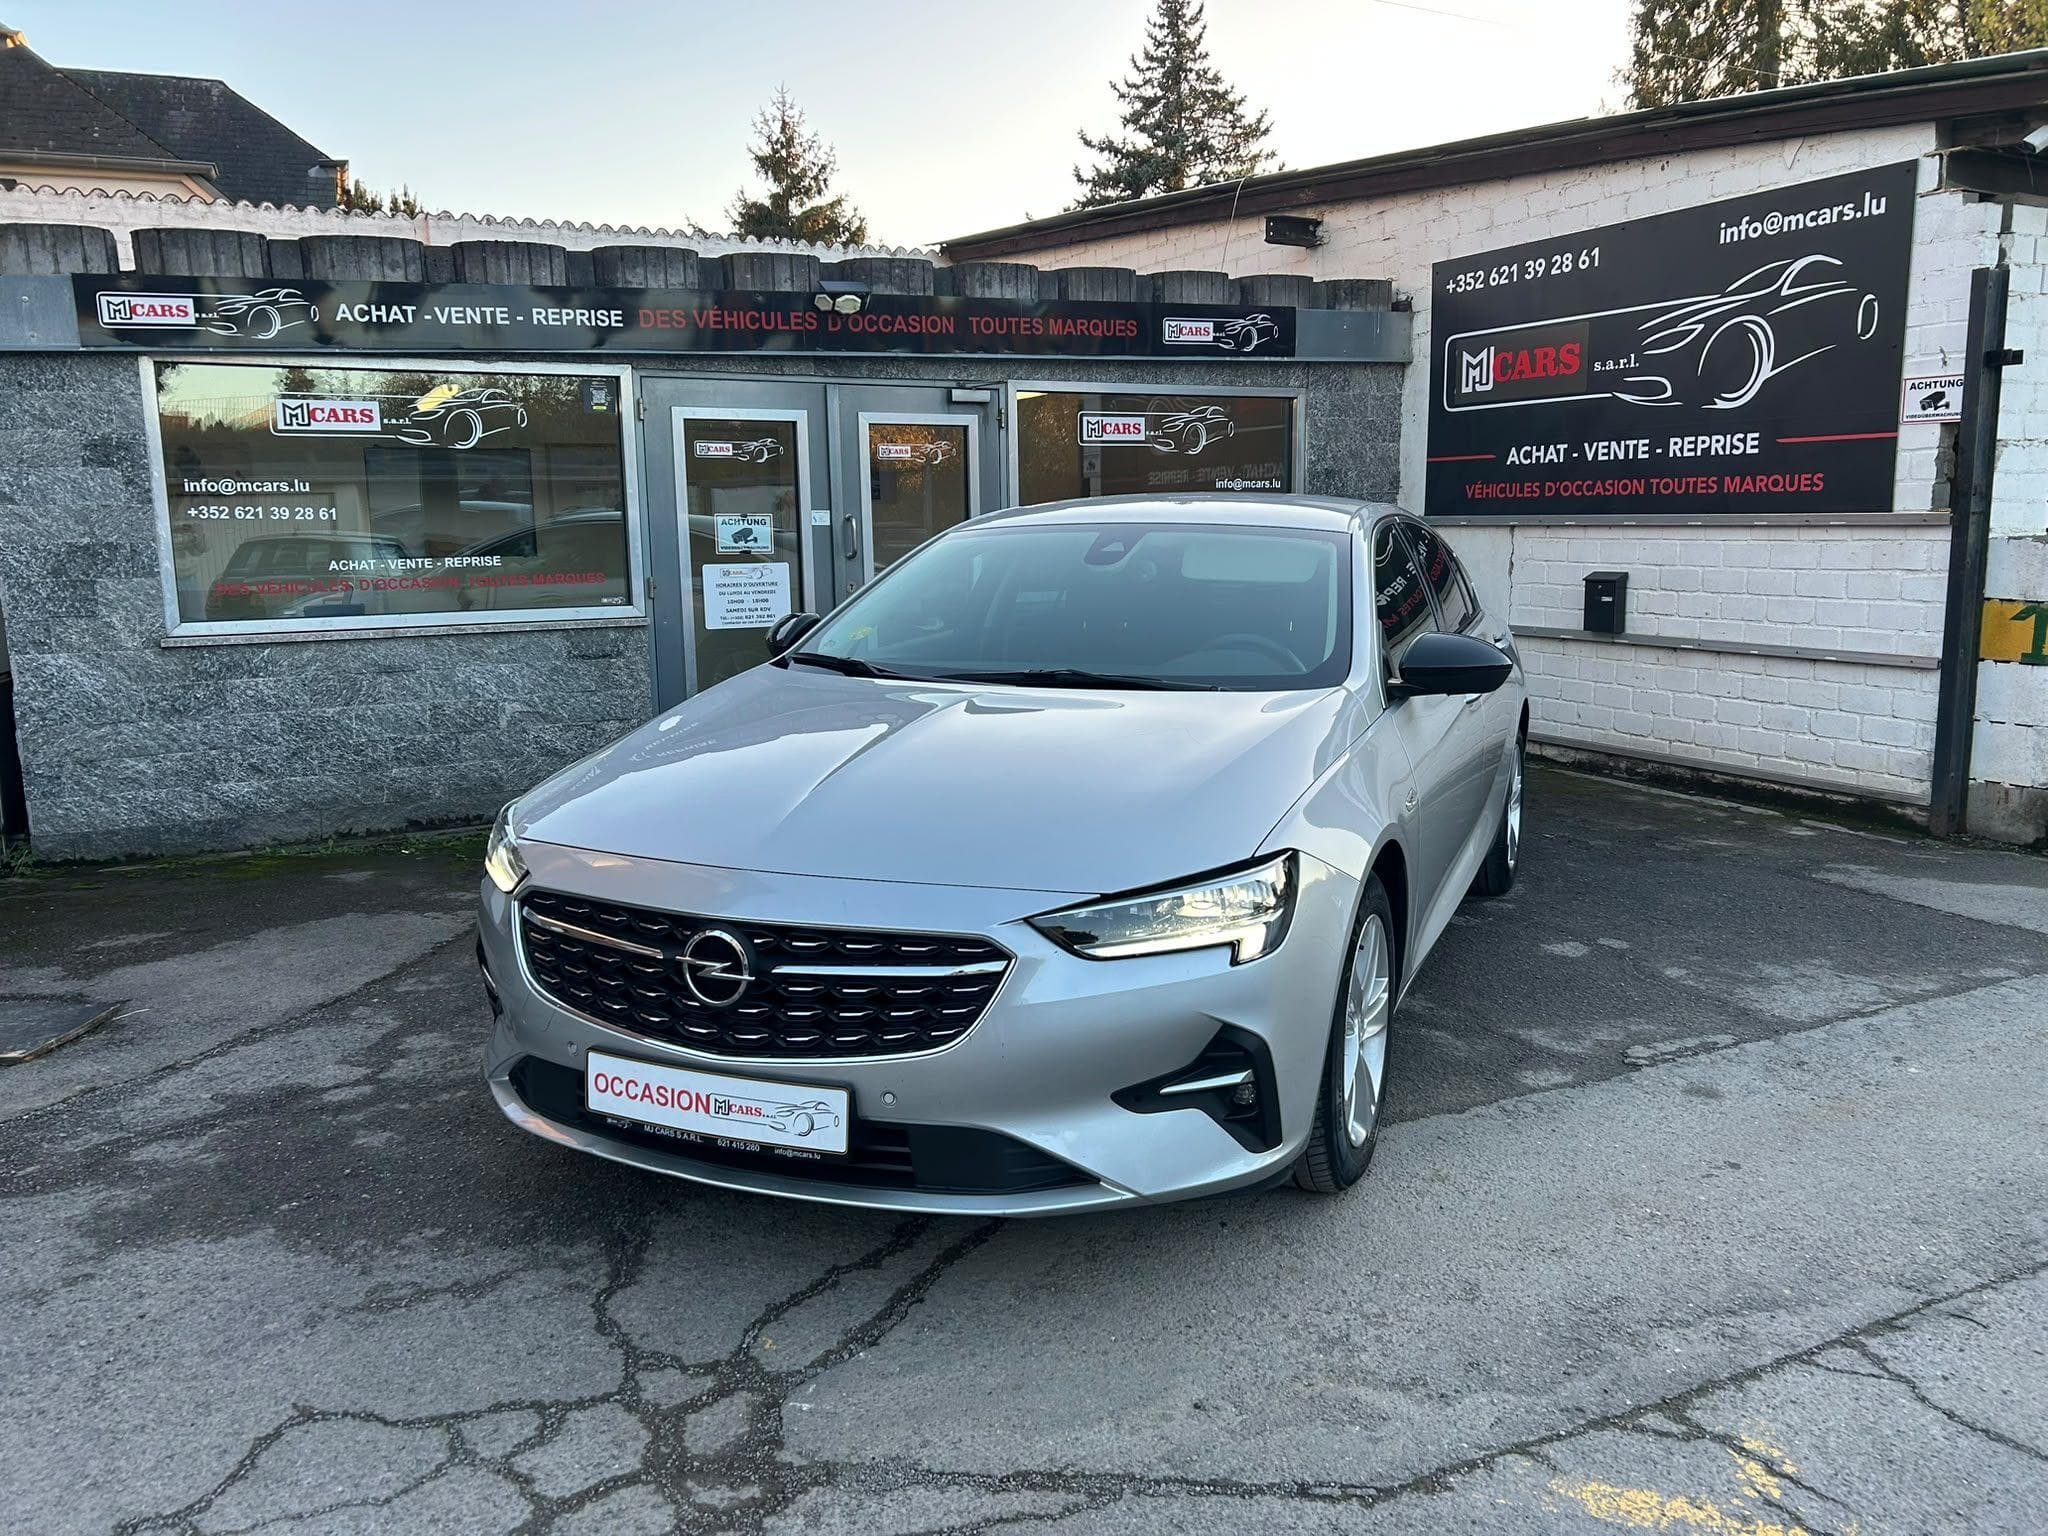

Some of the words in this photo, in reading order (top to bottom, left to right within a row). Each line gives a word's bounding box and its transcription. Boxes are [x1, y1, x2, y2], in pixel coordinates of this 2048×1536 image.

[1719, 192, 1887, 246] info@mcars.lu
[1446, 269, 1485, 295] +352
[1489, 263, 1518, 287] 621
[1524, 258, 1546, 281] 39
[1550, 253, 1574, 275] 28
[1578, 247, 1601, 270] 61
[335, 303, 417, 324] ACHAT
[532, 307, 625, 328] REPRISE
[638, 308, 687, 329] DES
[692, 305, 818, 331] VÉHICULES
[828, 312, 955, 334] D'OCCASION
[968, 315, 1044, 336] TOUTES
[1049, 318, 1138, 338] MARQUES
[1593, 353, 1640, 372] s.a.r.l.
[1909, 378, 1964, 391] ACHTUNG
[1505, 443, 1569, 466] ACHAT
[1583, 438, 1650, 462] VENTE
[1668, 432, 1761, 458] REPRISE
[183, 478, 311, 496] info@mcars.lu
[1215, 478, 1281, 491] info@mcars.lu
[1465, 478, 1541, 499] VÉHICULES
[1544, 478, 1645, 498] D'OCCASION
[1650, 475, 1718, 495] TOUTES
[1723, 472, 1825, 493] MARQUES
[187, 505, 230, 520] +352
[234, 506, 264, 520] 621
[270, 506, 290, 520] 39
[294, 507, 315, 520] 28
[319, 507, 337, 521] 61
[720, 518, 767, 526] ACHTUNG
[328, 559, 376, 571] ACHAT
[387, 558, 433, 571] VENTE
[445, 555, 502, 568] REPRISE
[532, 572, 608, 586] MARQUES
[594, 1072, 711, 1115] OCCASION
